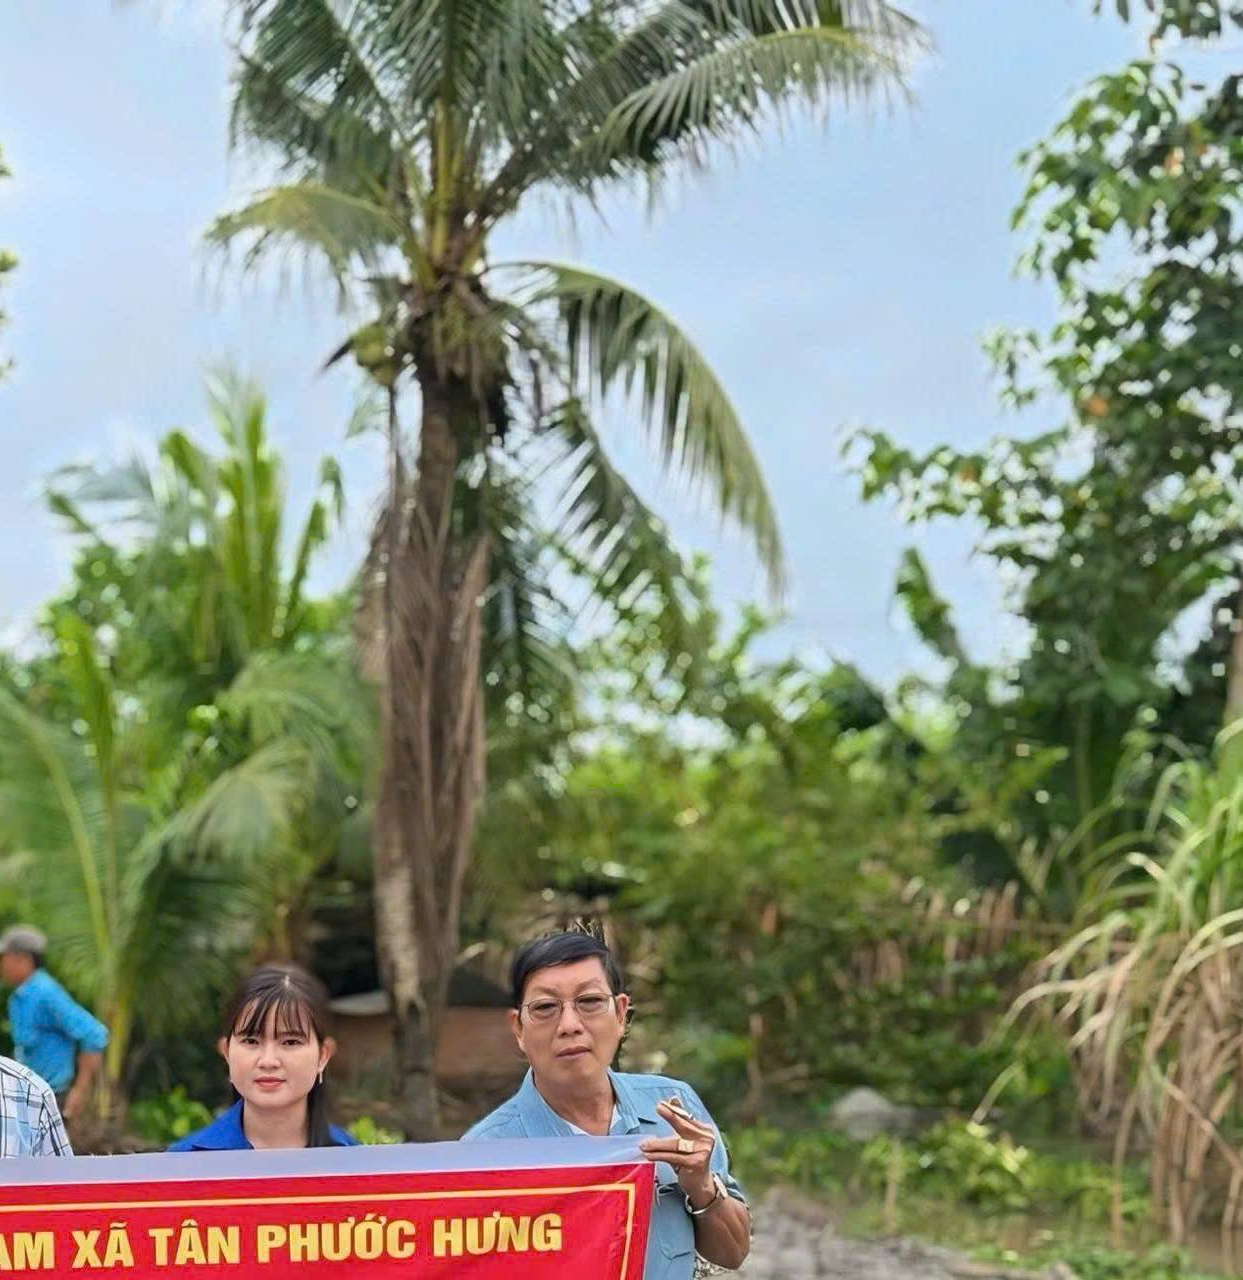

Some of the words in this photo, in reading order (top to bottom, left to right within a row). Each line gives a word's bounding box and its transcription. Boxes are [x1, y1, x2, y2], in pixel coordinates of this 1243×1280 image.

[72, 1221, 136, 1269] XÃ
[148, 1219, 242, 1267] TÂN
[257, 1212, 418, 1264] PHƯỚC
[433, 1211, 564, 1258] HƯNG
